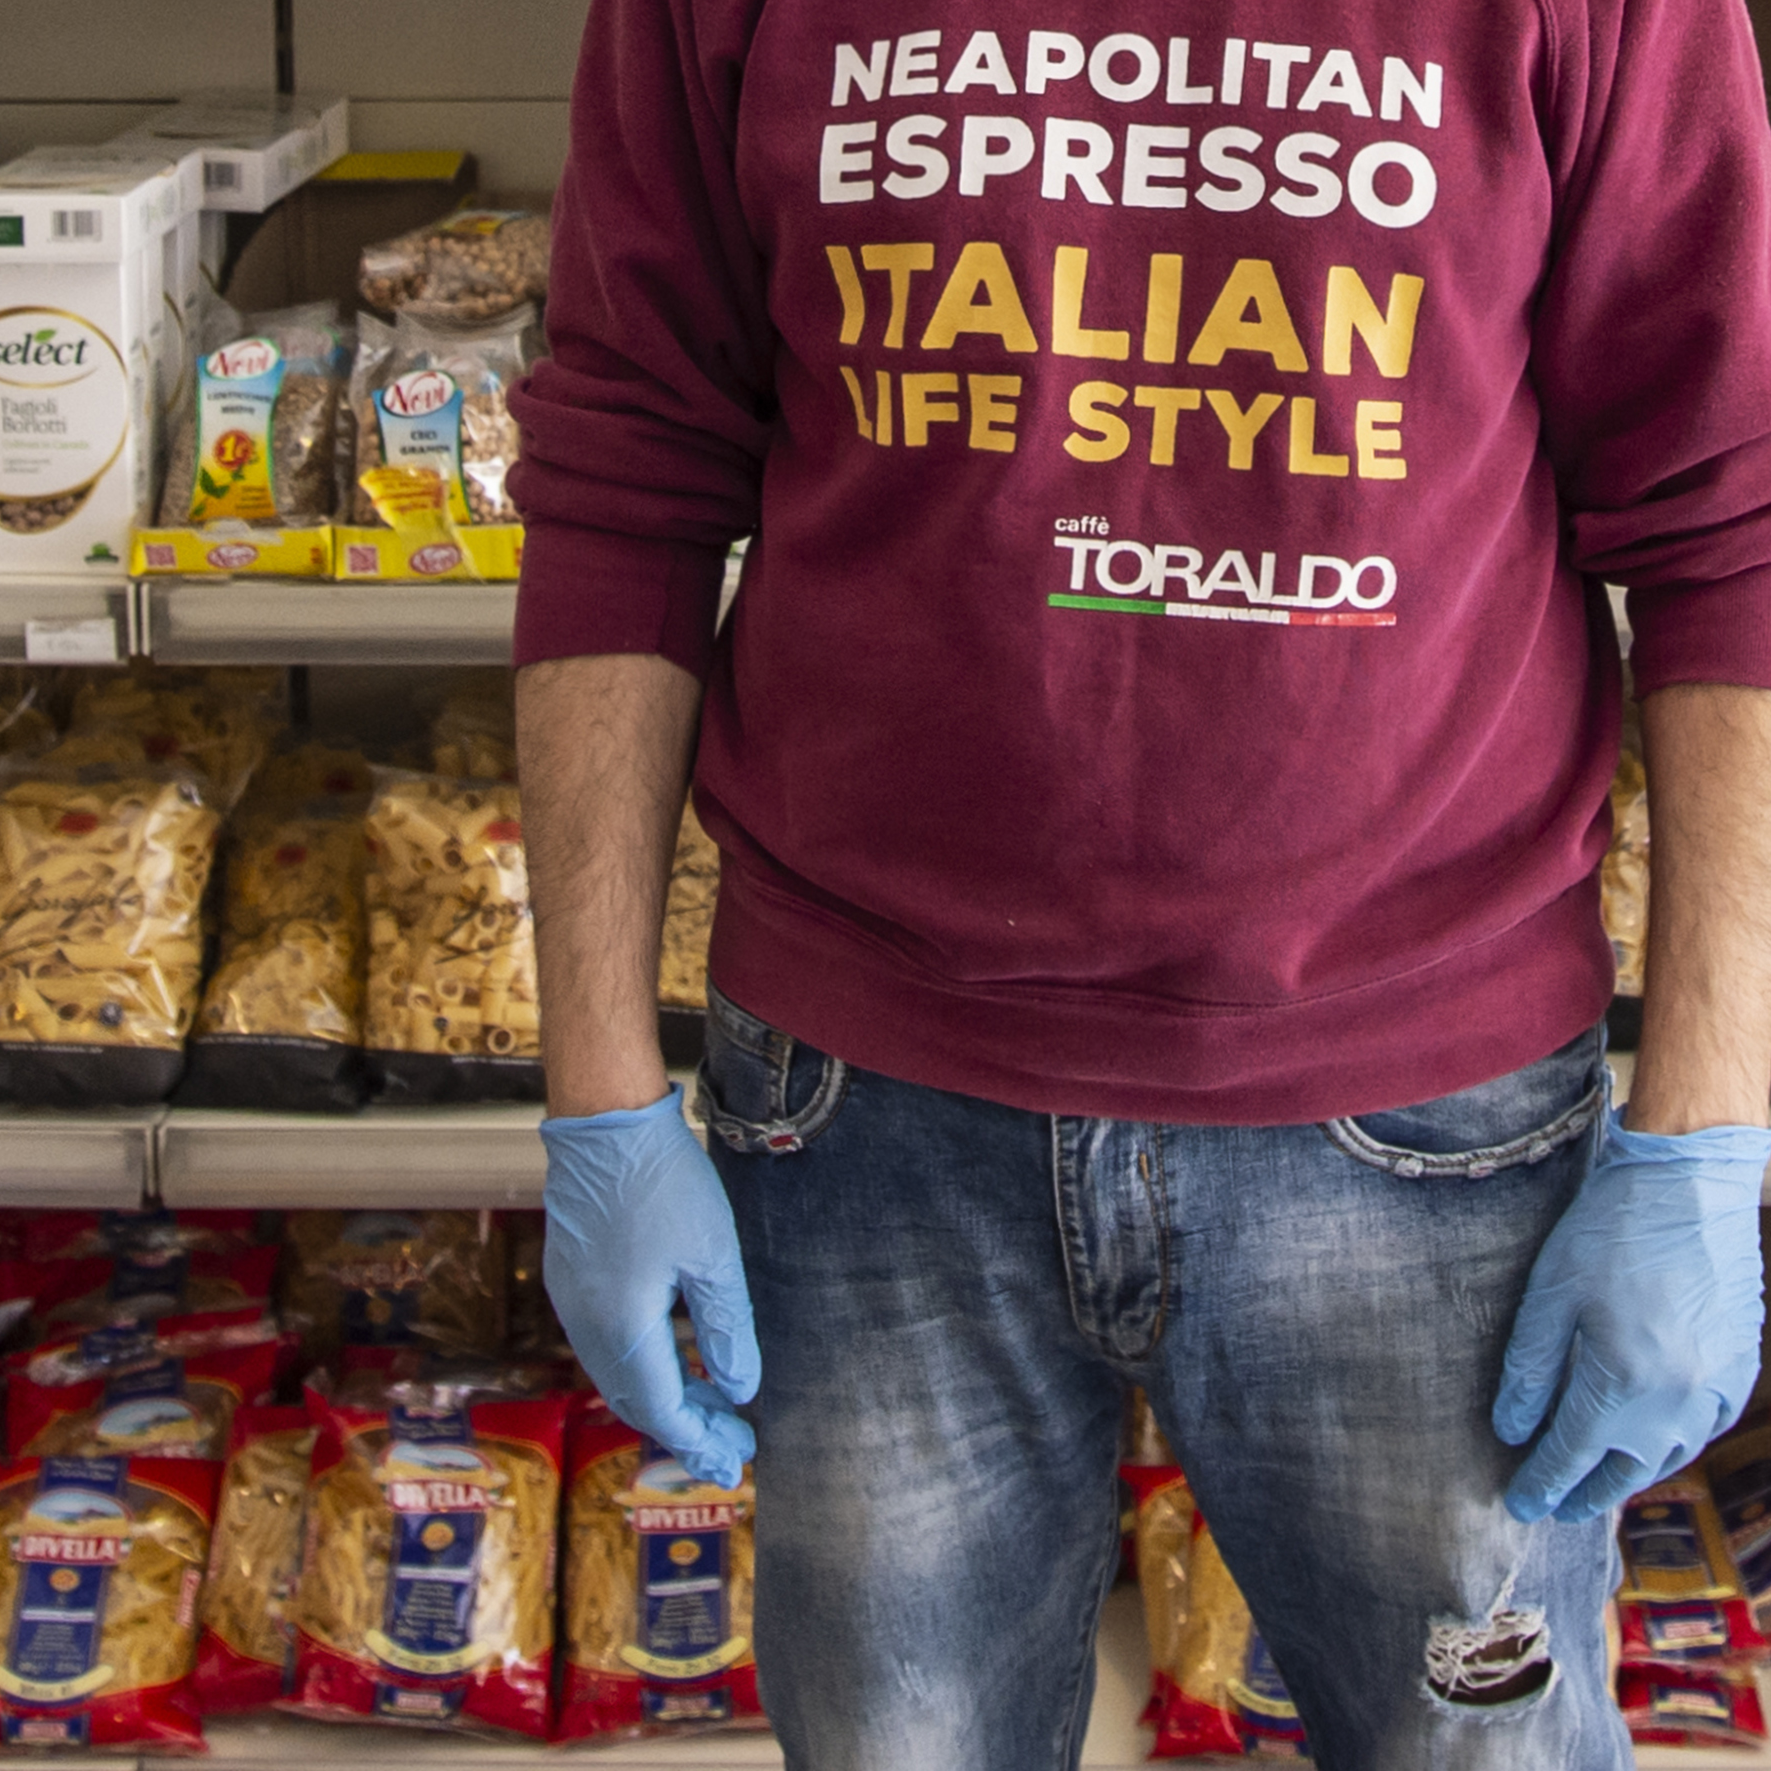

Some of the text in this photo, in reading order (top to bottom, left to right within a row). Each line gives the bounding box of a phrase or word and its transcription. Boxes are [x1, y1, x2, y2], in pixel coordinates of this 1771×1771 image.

[831, 29, 1445, 130] NEAPOLITAN
[819, 114, 1439, 229] ESPRESSO
[825, 241, 1425, 379] ITALIAN
[1, 397, 58, 421] Fagioli
[1062, 379, 1408, 480] STYLE
[1054, 515, 1110, 537] caffè
[1053, 536, 1397, 610] TORALDO
[392, 1482, 488, 1507] DIVELLA
[638, 1505, 730, 1529] DIVELLA
[24, 1536, 117, 1560] DIVELLA
